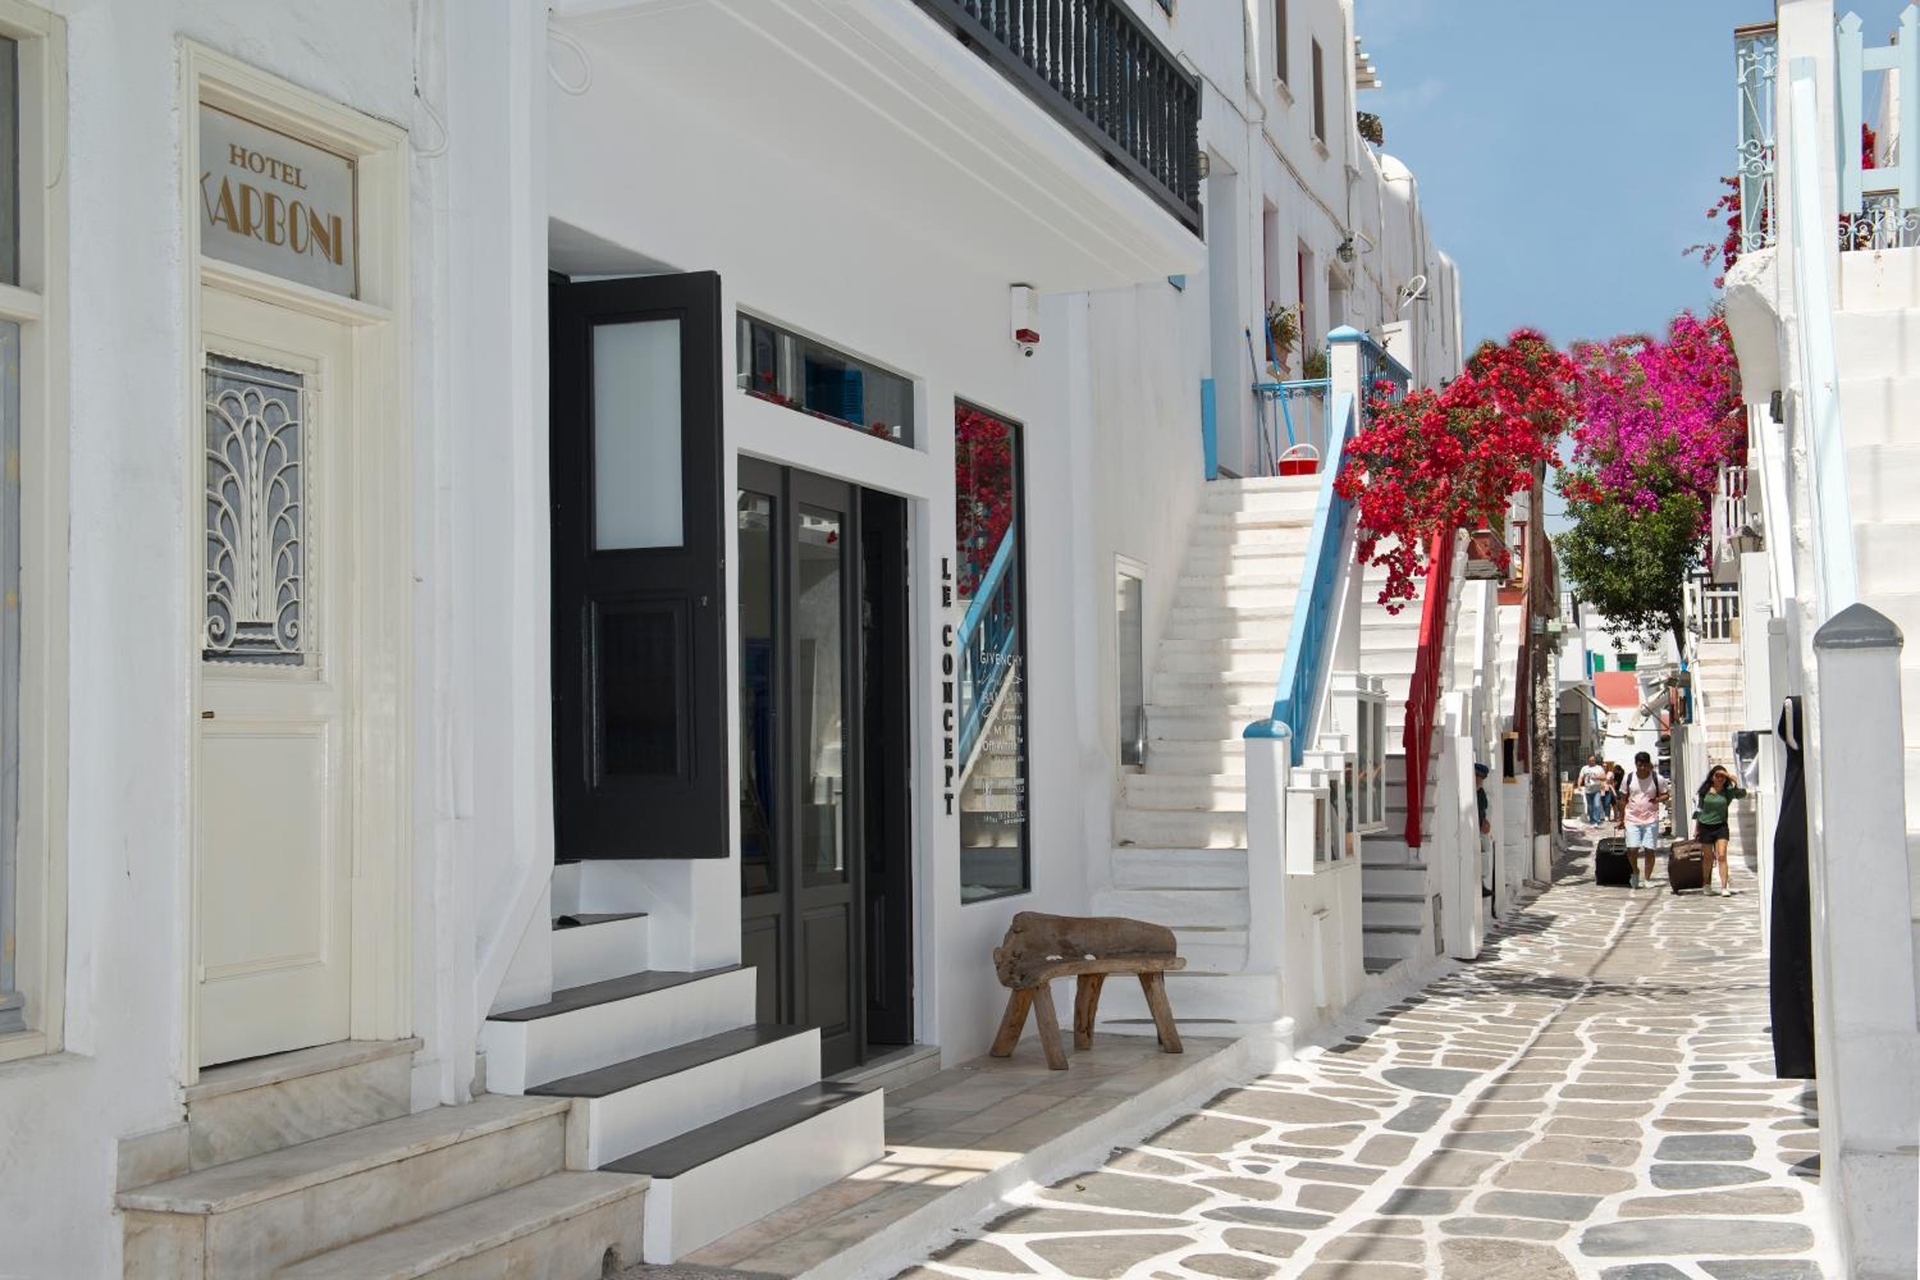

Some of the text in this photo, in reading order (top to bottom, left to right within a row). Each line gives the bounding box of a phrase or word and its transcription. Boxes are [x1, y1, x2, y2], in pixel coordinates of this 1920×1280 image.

[228, 143, 308, 191] HOTEL
[980, 652, 1023, 666] GIVENCHY
[941, 558, 954, 815] LE CONCEPT
[982, 692, 1024, 704] BAAIN
